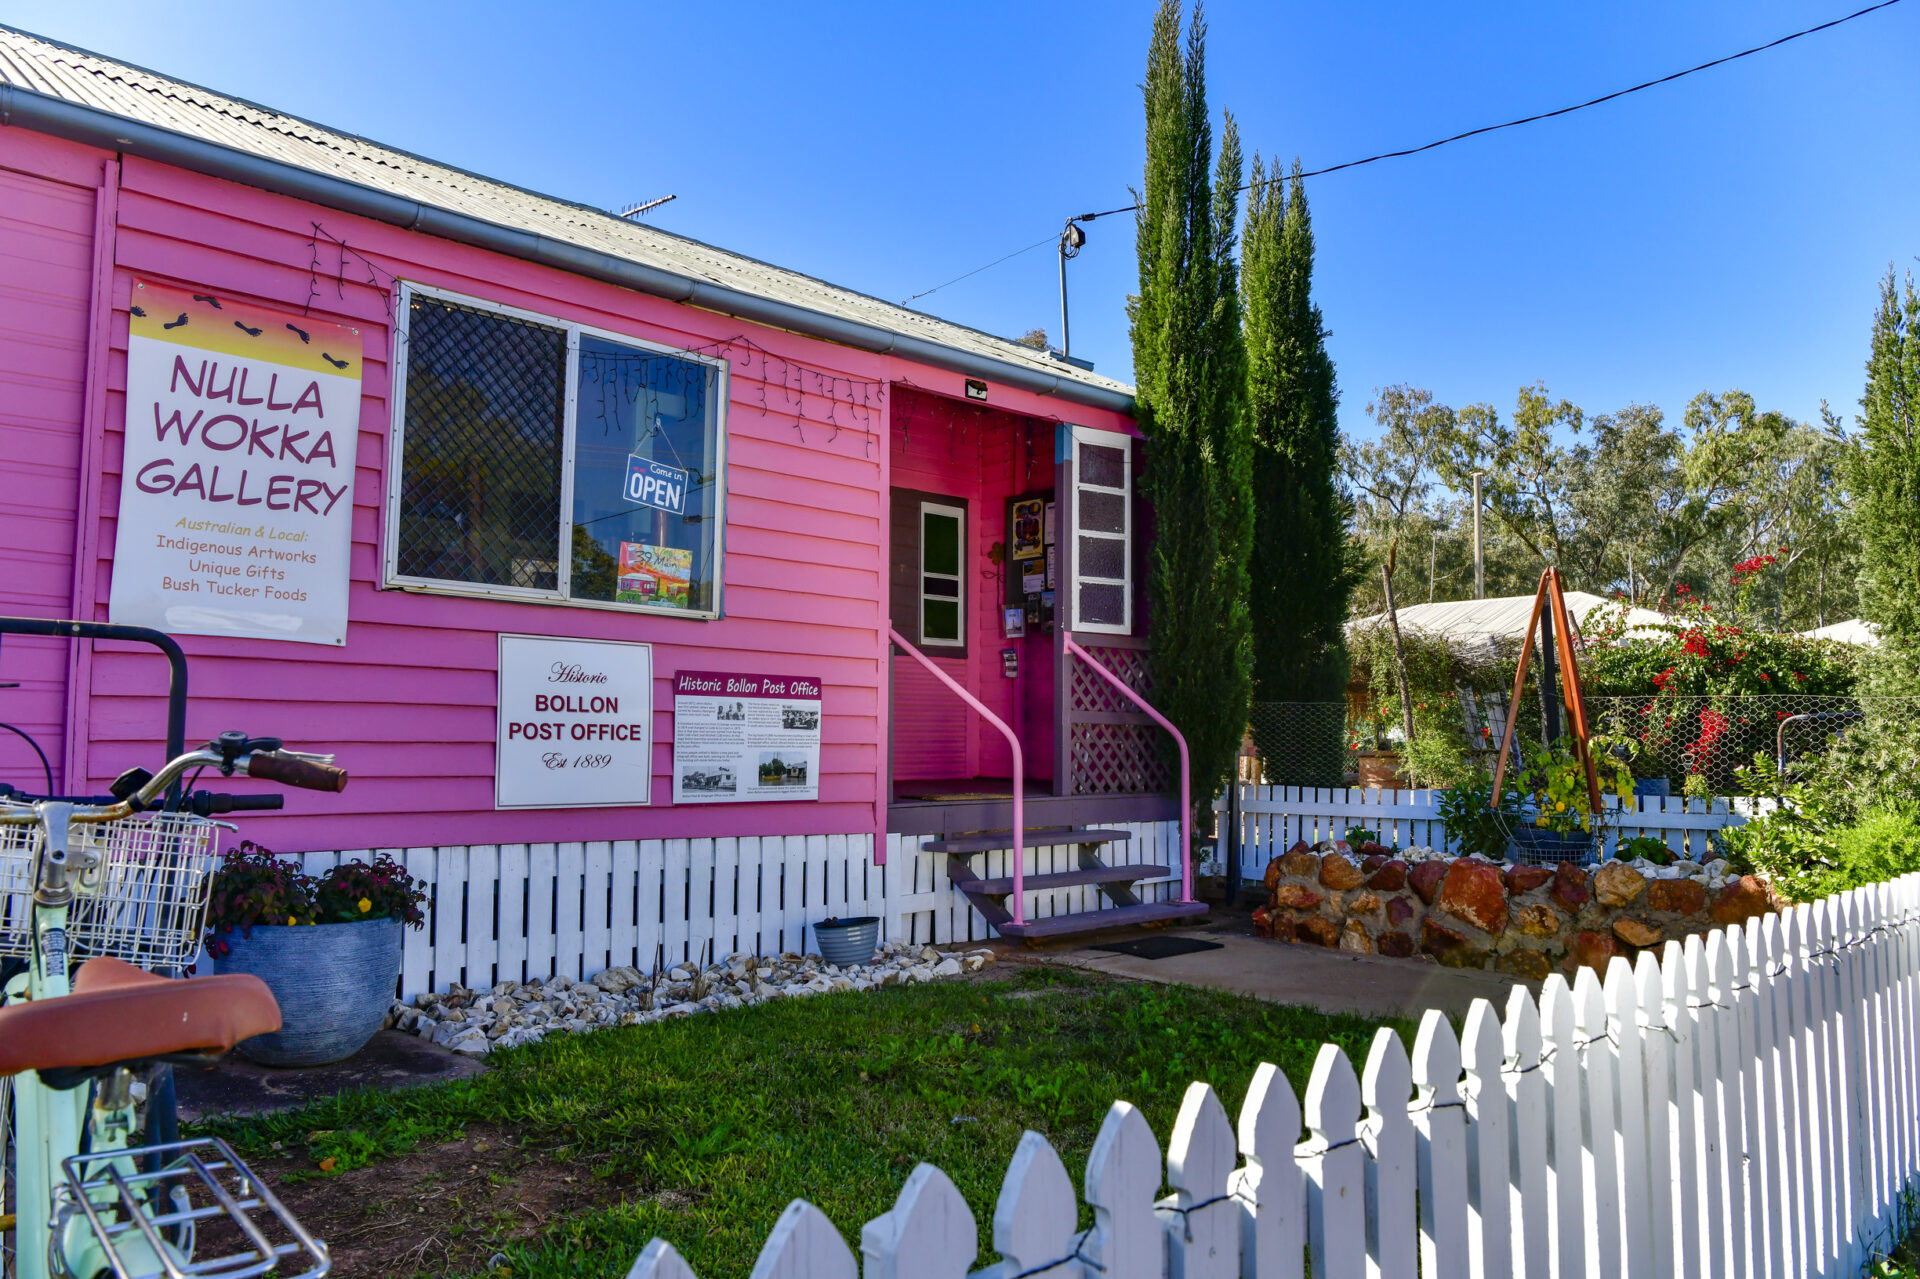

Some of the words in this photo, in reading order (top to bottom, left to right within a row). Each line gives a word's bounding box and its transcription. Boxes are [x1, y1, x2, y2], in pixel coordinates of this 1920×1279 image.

[170, 355, 324, 418] NULLA
[154, 402, 337, 468] WOKKA
[650, 463, 673, 477] Come
[674, 470, 683, 481] in
[136, 458, 348, 516] GALLERY
[630, 472, 681, 510] OPEN
[175, 517, 251, 537] Australian
[254, 526, 265, 538] &
[268, 527, 309, 542] Local:
[156, 535, 242, 557] Indigenous
[248, 545, 316, 564] Artworks
[189, 559, 241, 578] Unique
[246, 565, 285, 581] Gifts
[162, 576, 200, 593] Bush
[207, 582, 259, 597] Tucker
[264, 586, 307, 601] Foods
[547, 661, 608, 684] Historic
[679, 675, 721, 692] Historic
[726, 678, 757, 694] Bollon
[762, 680, 786, 694] Post
[790, 681, 819, 696] Office
[535, 694, 619, 714] BOLLON
[508, 722, 566, 741] POST
[570, 722, 641, 741] OFFICE
[541, 752, 567, 770] Est
[573, 754, 612, 769] 1889
